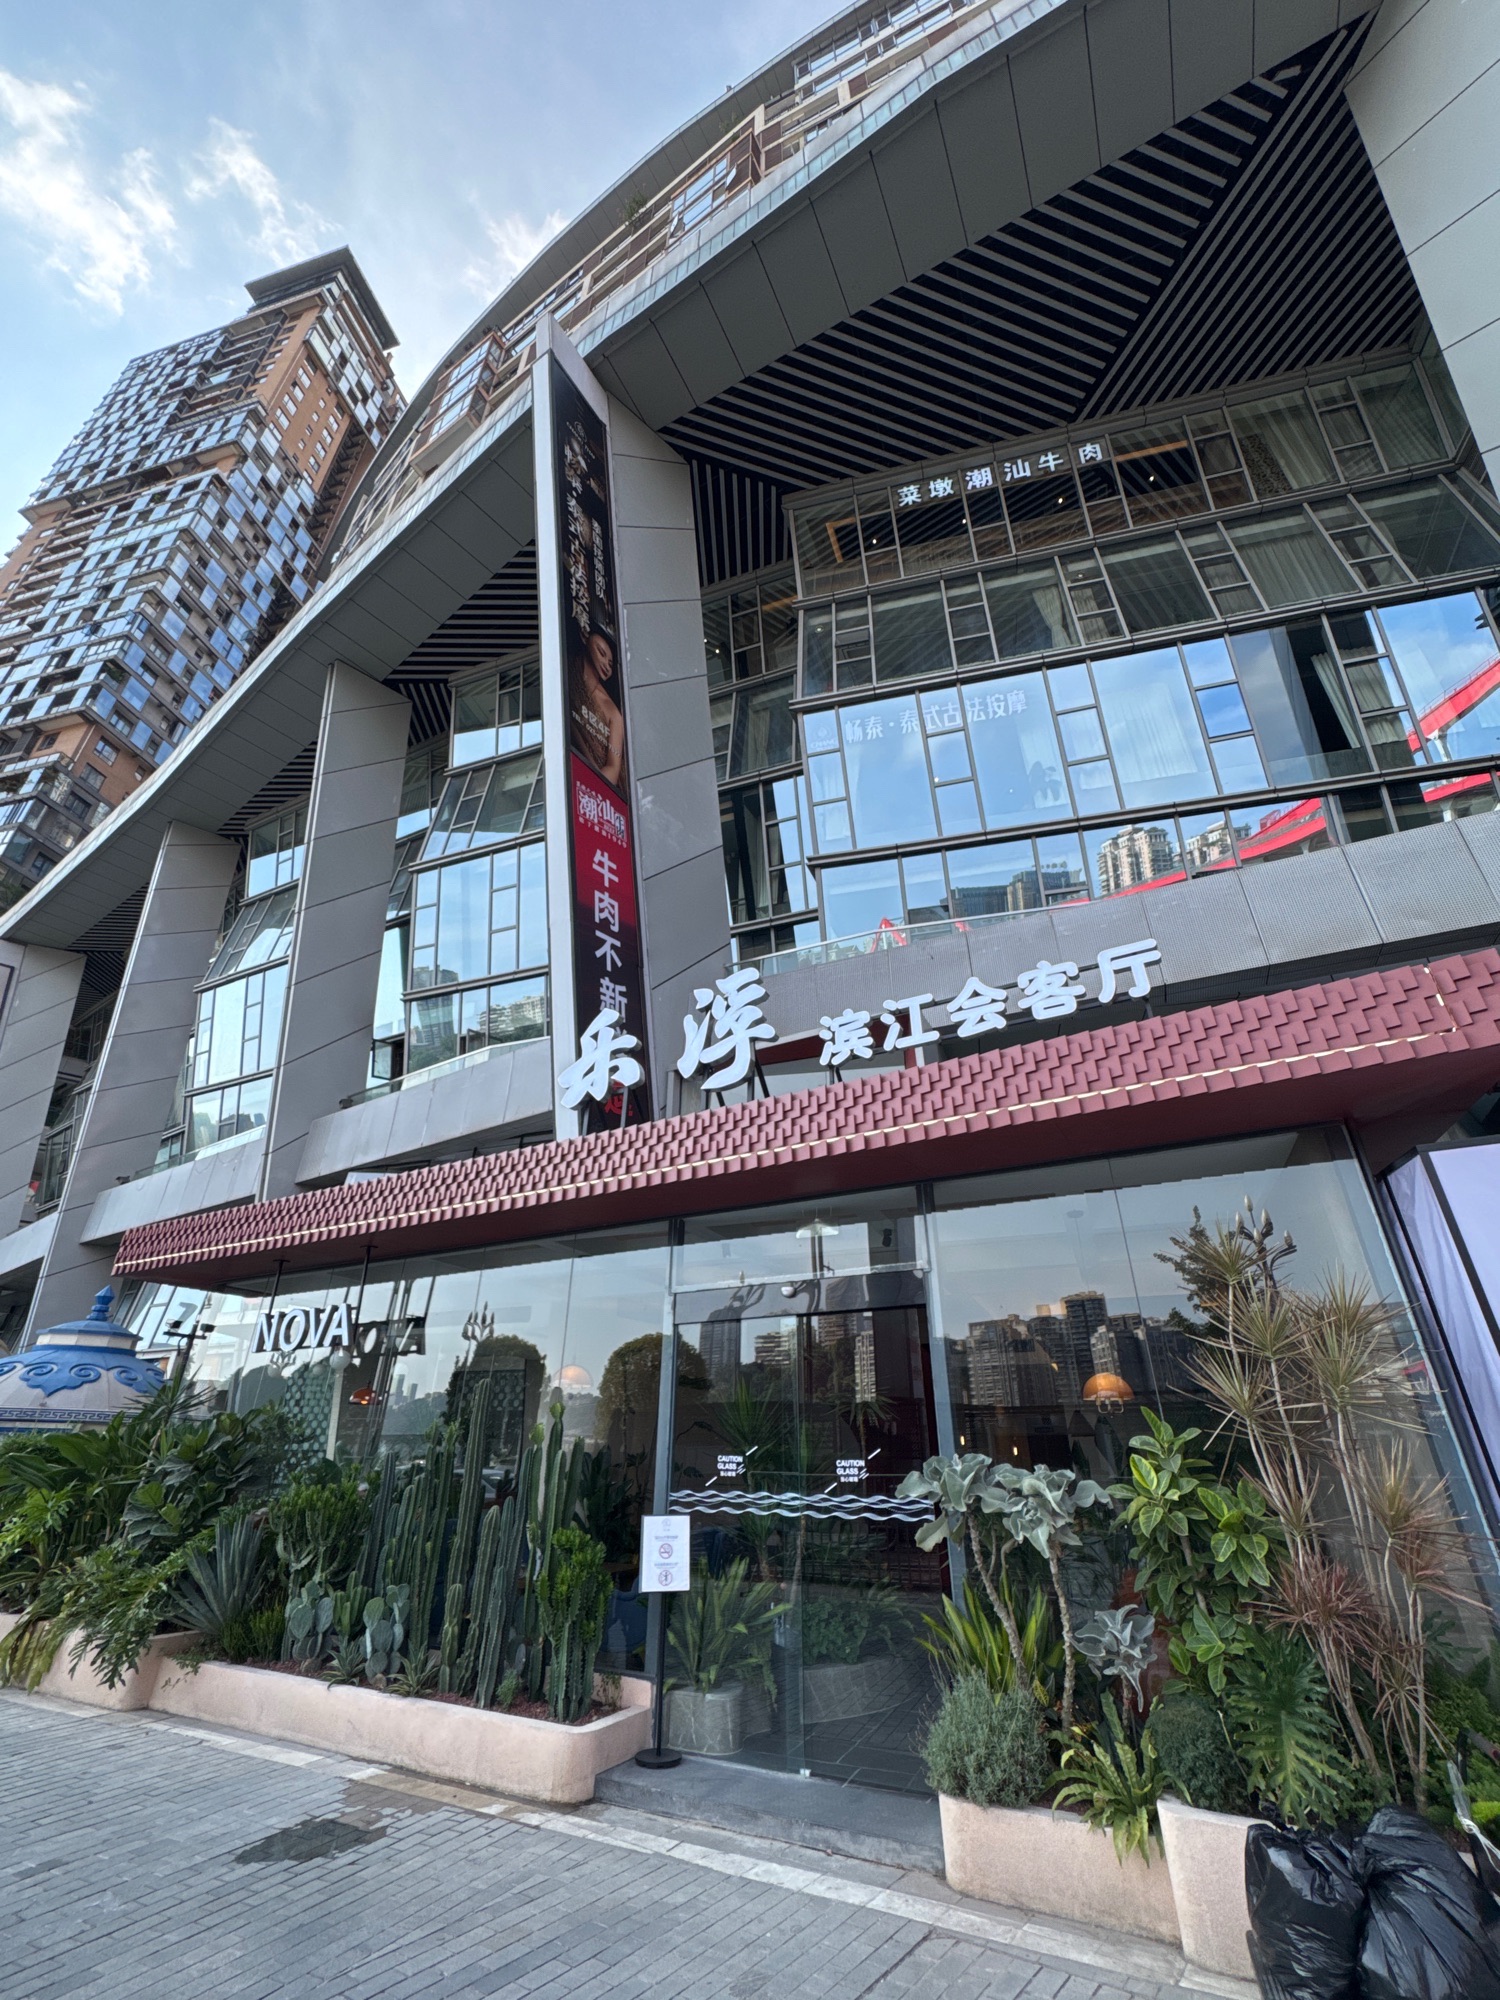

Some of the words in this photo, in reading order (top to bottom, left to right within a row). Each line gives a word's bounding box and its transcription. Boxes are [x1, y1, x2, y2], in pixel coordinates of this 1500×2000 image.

[897, 443, 1103, 507] 菜墩潮汕牛肉
[818, 937, 1163, 1067] 滨江会客厅
[251, 1302, 354, 1353] NOVA
[717, 1455, 744, 1463] CAUTION
[835, 1459, 866, 1467] CAUTION
[716, 1462, 738, 1470] GLASS
[836, 1467, 859, 1475] GLASS
